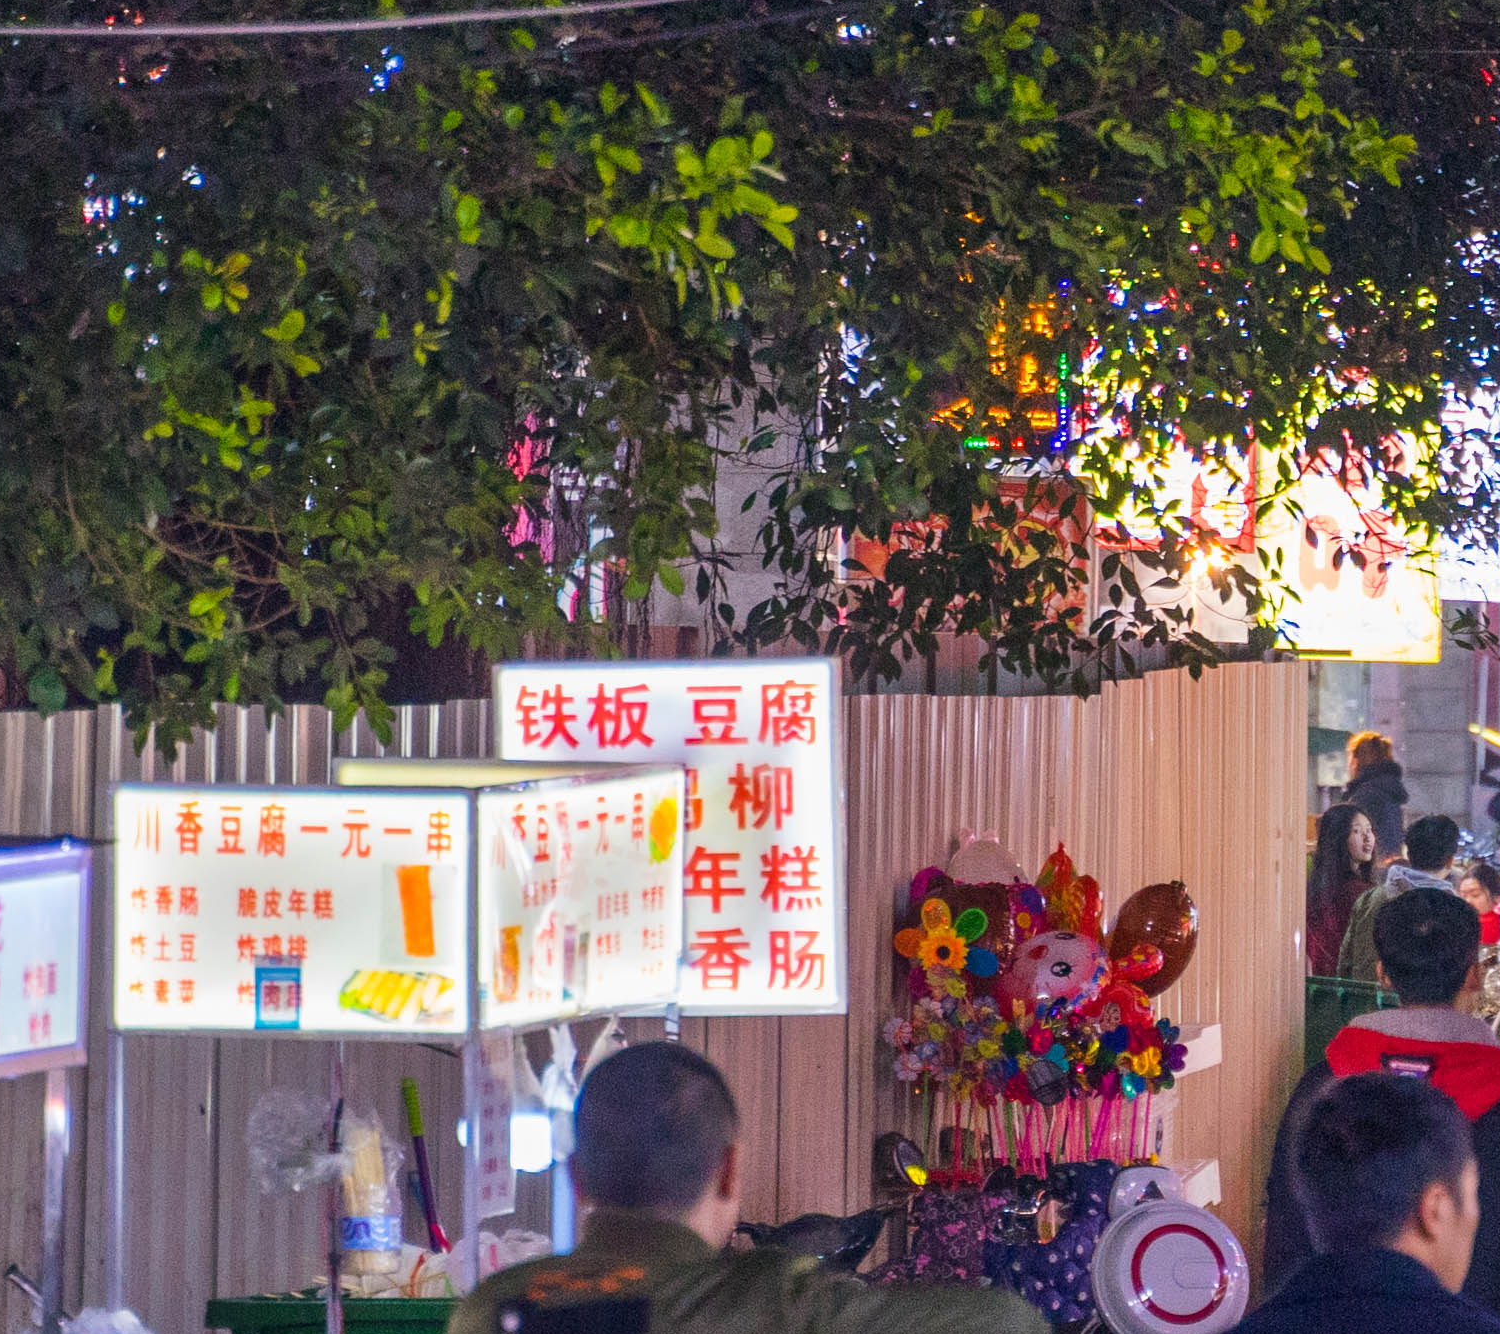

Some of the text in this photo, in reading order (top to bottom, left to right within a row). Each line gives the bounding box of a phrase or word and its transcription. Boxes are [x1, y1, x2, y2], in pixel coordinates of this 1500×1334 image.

[515, 679, 819, 749] 铁板 豆腐
[134, 801, 452, 860] 川香豆腐一元一串
[131, 885, 334, 920] 炸香肠 脆皮年糕
[684, 845, 823, 915] 年糕
[130, 932, 197, 964] 炸土豆
[689, 927, 826, 993] 香肠
